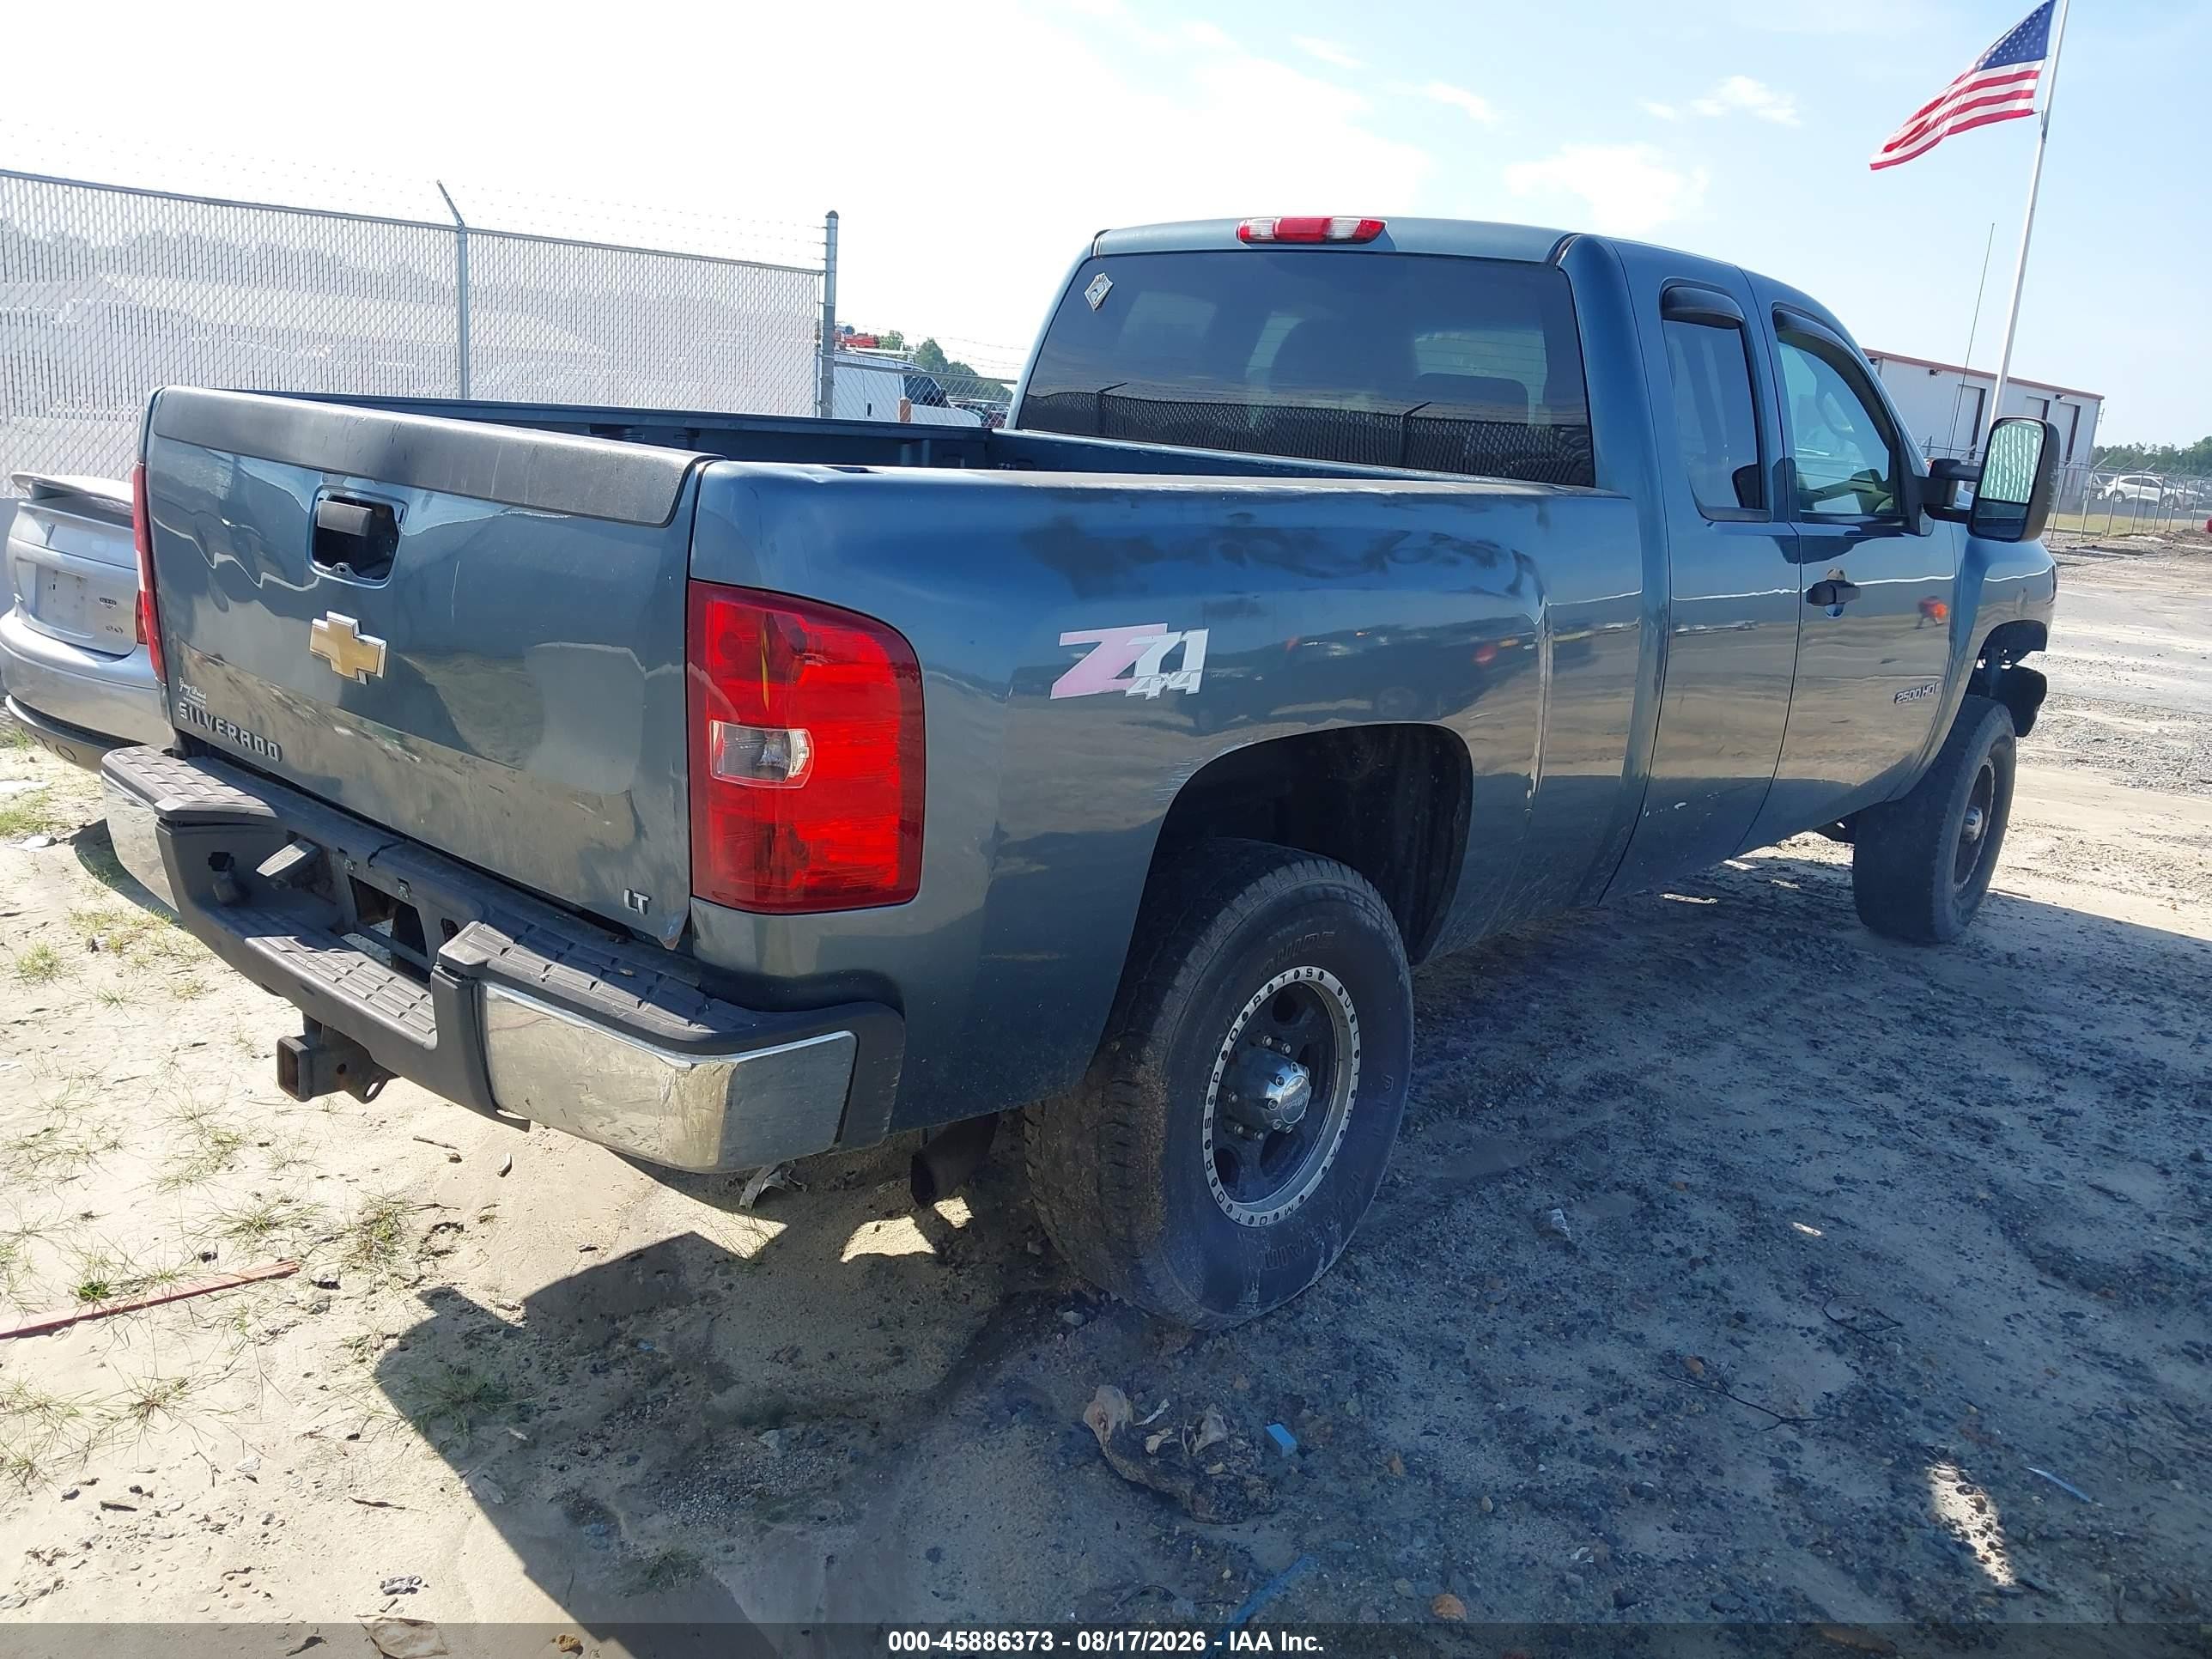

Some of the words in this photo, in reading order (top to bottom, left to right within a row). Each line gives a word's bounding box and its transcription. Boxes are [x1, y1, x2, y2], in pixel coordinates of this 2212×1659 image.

[1050, 623, 1210, 700] Z71
[179, 702, 283, 763] SILVERADO
[623, 888, 650, 915] LT
